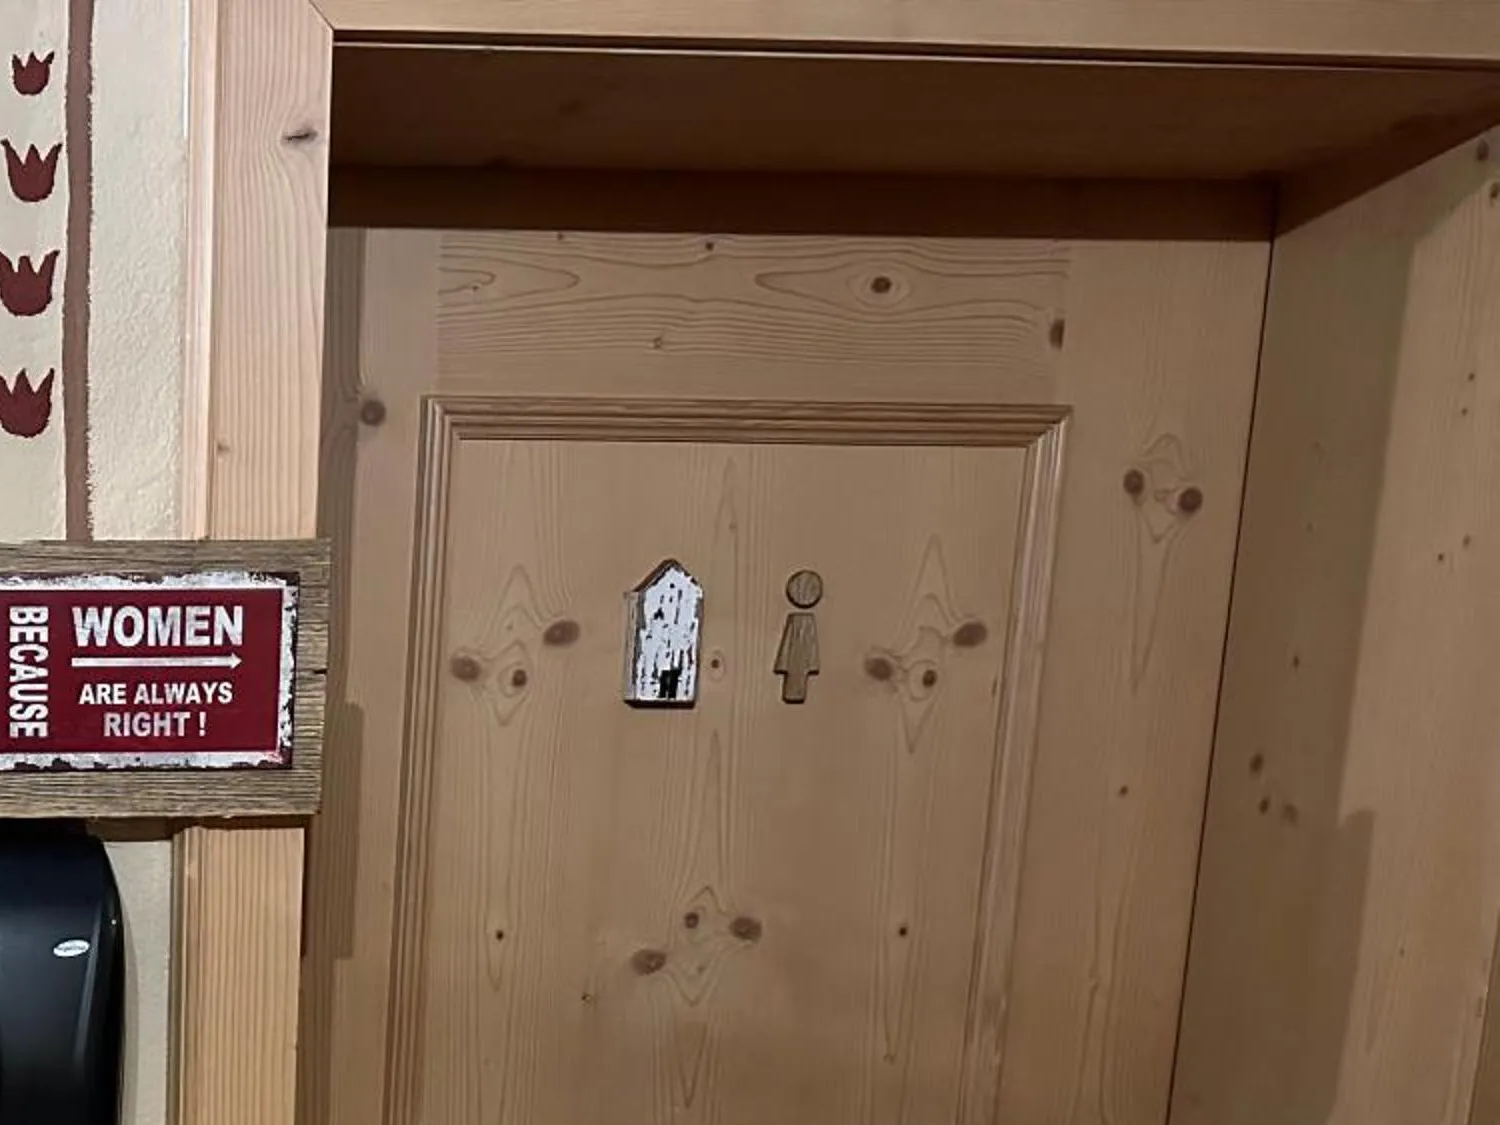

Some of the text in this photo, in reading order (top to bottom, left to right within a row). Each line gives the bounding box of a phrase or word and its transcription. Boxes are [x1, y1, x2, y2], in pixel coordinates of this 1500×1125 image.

[72, 606, 243, 647] WOMEN
[9, 606, 48, 738] BECAUSE
[79, 682, 232, 704] ARE ALWAYS
[104, 712, 190, 736] RIGHT
